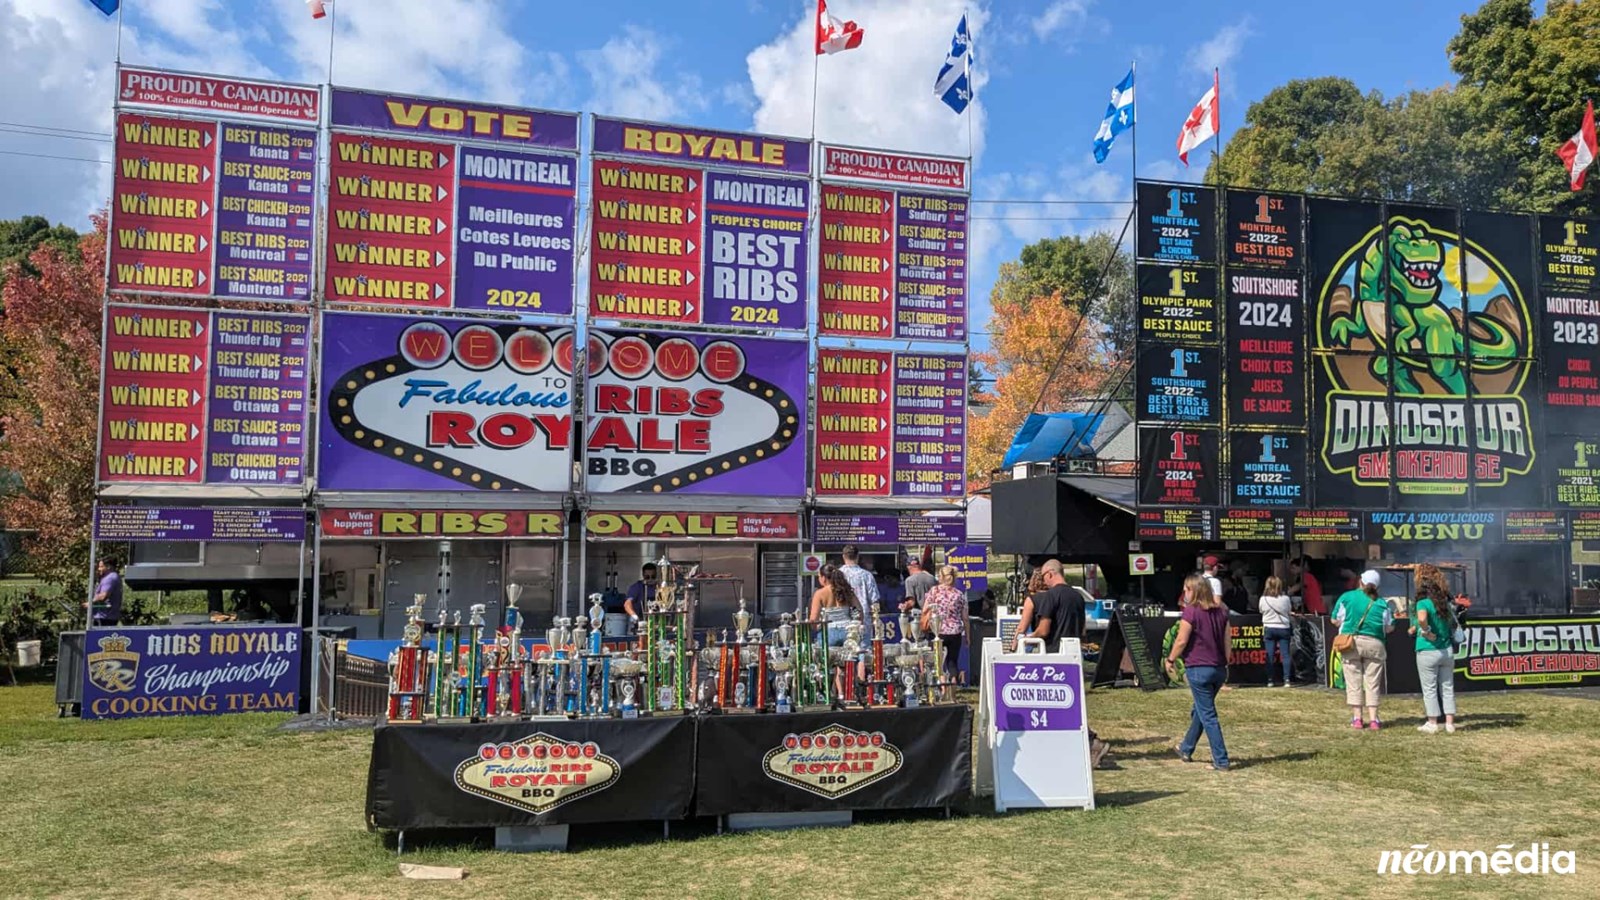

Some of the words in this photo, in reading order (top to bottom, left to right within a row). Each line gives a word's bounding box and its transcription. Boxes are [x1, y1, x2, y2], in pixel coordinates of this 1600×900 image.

[128, 74, 217, 97] PROUDLY
[223, 84, 313, 107] CANADIAN
[139, 92, 164, 101] 100%
[167, 95, 208, 107] Canadian
[211, 100, 239, 110] Owned
[242, 103, 258, 112] and
[261, 104, 299, 117] Operated
[386, 101, 531, 138] VOTE
[225, 129, 257, 144] BEST
[260, 132, 289, 146] RIBS
[292, 137, 313, 147] 2019
[250, 146, 289, 160] Kanata
[624, 128, 784, 165] ROYALE
[465, 155, 570, 185] MONTREAL
[832, 152, 893, 170] PROUDLY
[897, 160, 959, 176] CANADIAN
[714, 180, 804, 207] MONTREAL
[470, 206, 563, 228] Meilleures
[712, 214, 759, 228] PEOPLE'S
[762, 219, 803, 231] CHOICE
[1152, 216, 1199, 226] MONTREAL
[900, 225, 918, 237] BEST
[920, 227, 946, 240] SAUCE
[1161, 227, 1189, 238] 2024
[1240, 223, 1287, 234] MONTREAL
[461, 228, 509, 245] Cotes
[513, 233, 570, 250] Levees
[908, 238, 946, 251] Sudbury
[1249, 233, 1278, 243] 2022
[712, 230, 800, 268] BEST
[1235, 243, 1263, 255] BEST
[1267, 245, 1293, 257] RIBS
[1546, 244, 1575, 254] OLYMPIC
[1578, 247, 1597, 255] PARK
[474, 252, 497, 267] Du
[501, 254, 557, 272] Public
[1560, 255, 1583, 263] 2022
[1549, 264, 1571, 274] BEST
[1574, 266, 1595, 276] RIBS
[714, 266, 798, 303] RIBS
[1232, 276, 1298, 296] SOUTHSHORE
[487, 289, 541, 308] 2024
[1143, 297, 1183, 307] OLYMPIC
[1186, 298, 1212, 308] PARK
[731, 306, 779, 323] 2024
[1162, 308, 1194, 317] 2022
[1239, 302, 1292, 328] 2024
[1143, 319, 1172, 330] BEST
[1175, 320, 1212, 332] SAUCE
[1554, 321, 1598, 344] 2023
[1240, 339, 1293, 354] MEILLEURE
[217, 353, 243, 365] BEST
[245, 354, 280, 367] SAUCE
[283, 357, 304, 365] 2021
[898, 357, 921, 368] BEST
[923, 358, 945, 369] RIBS
[1241, 360, 1271, 373] CHOIX
[1274, 360, 1293, 373] DES
[218, 366, 260, 379] Thunder
[262, 367, 280, 381] Bay
[898, 370, 945, 381] Amherstburg
[542, 377, 567, 388] TO
[1151, 378, 1206, 388] SOUTHSHORE
[1252, 380, 1283, 393] JUGES
[400, 379, 569, 408] Fabulous
[595, 384, 724, 417] RIBS
[1164, 387, 1194, 396] 2022
[1148, 395, 1173, 404] BEST
[1176, 397, 1199, 406] RIBS
[1201, 398, 1209, 406] &
[1243, 399, 1257, 412] DE
[1259, 399, 1292, 413] SAUCE
[1148, 405, 1174, 414] BEST
[1176, 406, 1209, 416] SAUCE
[426, 410, 711, 454] ROYALE
[1331, 400, 1526, 456] DINOSAUR
[212, 454, 235, 466] BEST
[237, 454, 276, 467] CHICKEN
[588, 457, 656, 476] BBQ
[1158, 461, 1201, 470] OTTAWA
[1358, 450, 1500, 479] SMOKEHOUSE
[231, 468, 276, 480] Ottawa
[1244, 464, 1290, 472] MONTREAL
[1165, 471, 1193, 480] 2024
[1254, 474, 1282, 483] 2022
[1237, 485, 1263, 496] BEST
[1265, 486, 1300, 496] SAUCE
[333, 519, 373, 527] happens
[381, 512, 508, 534] RIBS
[1371, 513, 1406, 523] WHAT
[1407, 513, 1414, 523] A
[761, 526, 786, 534] Royale
[1383, 524, 1484, 539] MENU
[1242, 627, 1264, 636] TAST
[147, 633, 200, 656] RIBS
[210, 631, 297, 656] ROYALE
[1471, 654, 1600, 675] SMOKEHOUS
[144, 653, 290, 696] Championship
[1010, 666, 1039, 681] Jack
[1043, 667, 1065, 681] Pot
[1011, 689, 1035, 701] CORN
[1037, 689, 1066, 701] BREAD
[91, 695, 217, 715] COOKING
[226, 691, 295, 709] TEAM
[1031, 710, 1048, 728] $4
[786, 735, 883, 747] WELCOME
[482, 745, 597, 759] WELCOME
[787, 753, 841, 764] Fabulous
[843, 752, 879, 761] RIBS
[483, 764, 547, 776] Fabulous
[550, 764, 592, 773] RIBS
[792, 762, 874, 775] ROYALE
[490, 774, 587, 788] ROYALE
[819, 776, 847, 784] BBQ
[522, 789, 555, 798] BBQ
